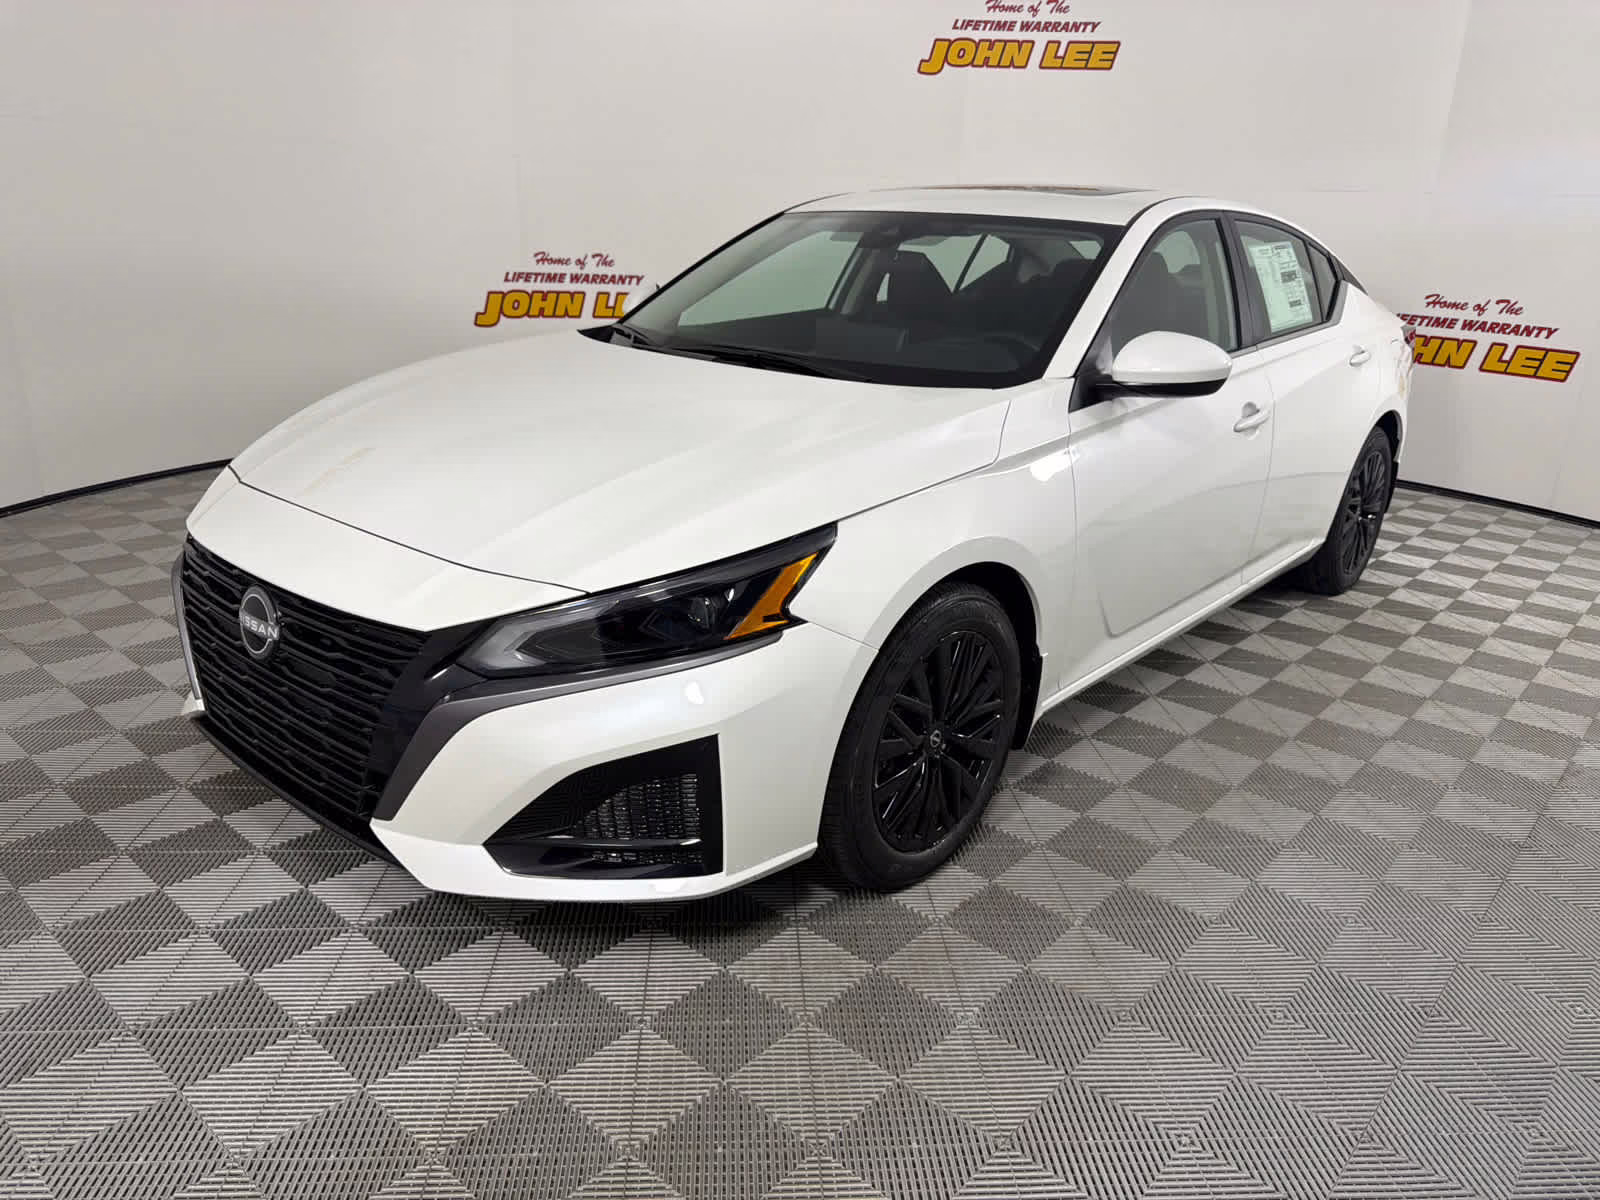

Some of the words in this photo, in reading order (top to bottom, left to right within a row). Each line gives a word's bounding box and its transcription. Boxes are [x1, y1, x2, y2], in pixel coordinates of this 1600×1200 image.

[984, 0, 1023, 13] Home
[1027, 0, 1041, 17] of
[1046, 0, 1071, 14] The
[952, 19, 1017, 32] LIFETIME
[1019, 20, 1102, 33] WARRANTY
[917, 37, 1035, 76] JOHN
[1039, 40, 1121, 70] LEE
[533, 251, 571, 266] Home
[574, 253, 588, 270] of
[591, 253, 615, 268] The
[503, 271, 567, 283] LIFETIME
[569, 273, 645, 286] WARRANTY
[474, 289, 586, 327] JOHN
[1424, 293, 1469, 311] Home
[1473, 299, 1490, 317] of
[1495, 299, 1524, 316] The
[1461, 319, 1560, 340] WARRANTY
[1479, 342, 1581, 383] LEE
